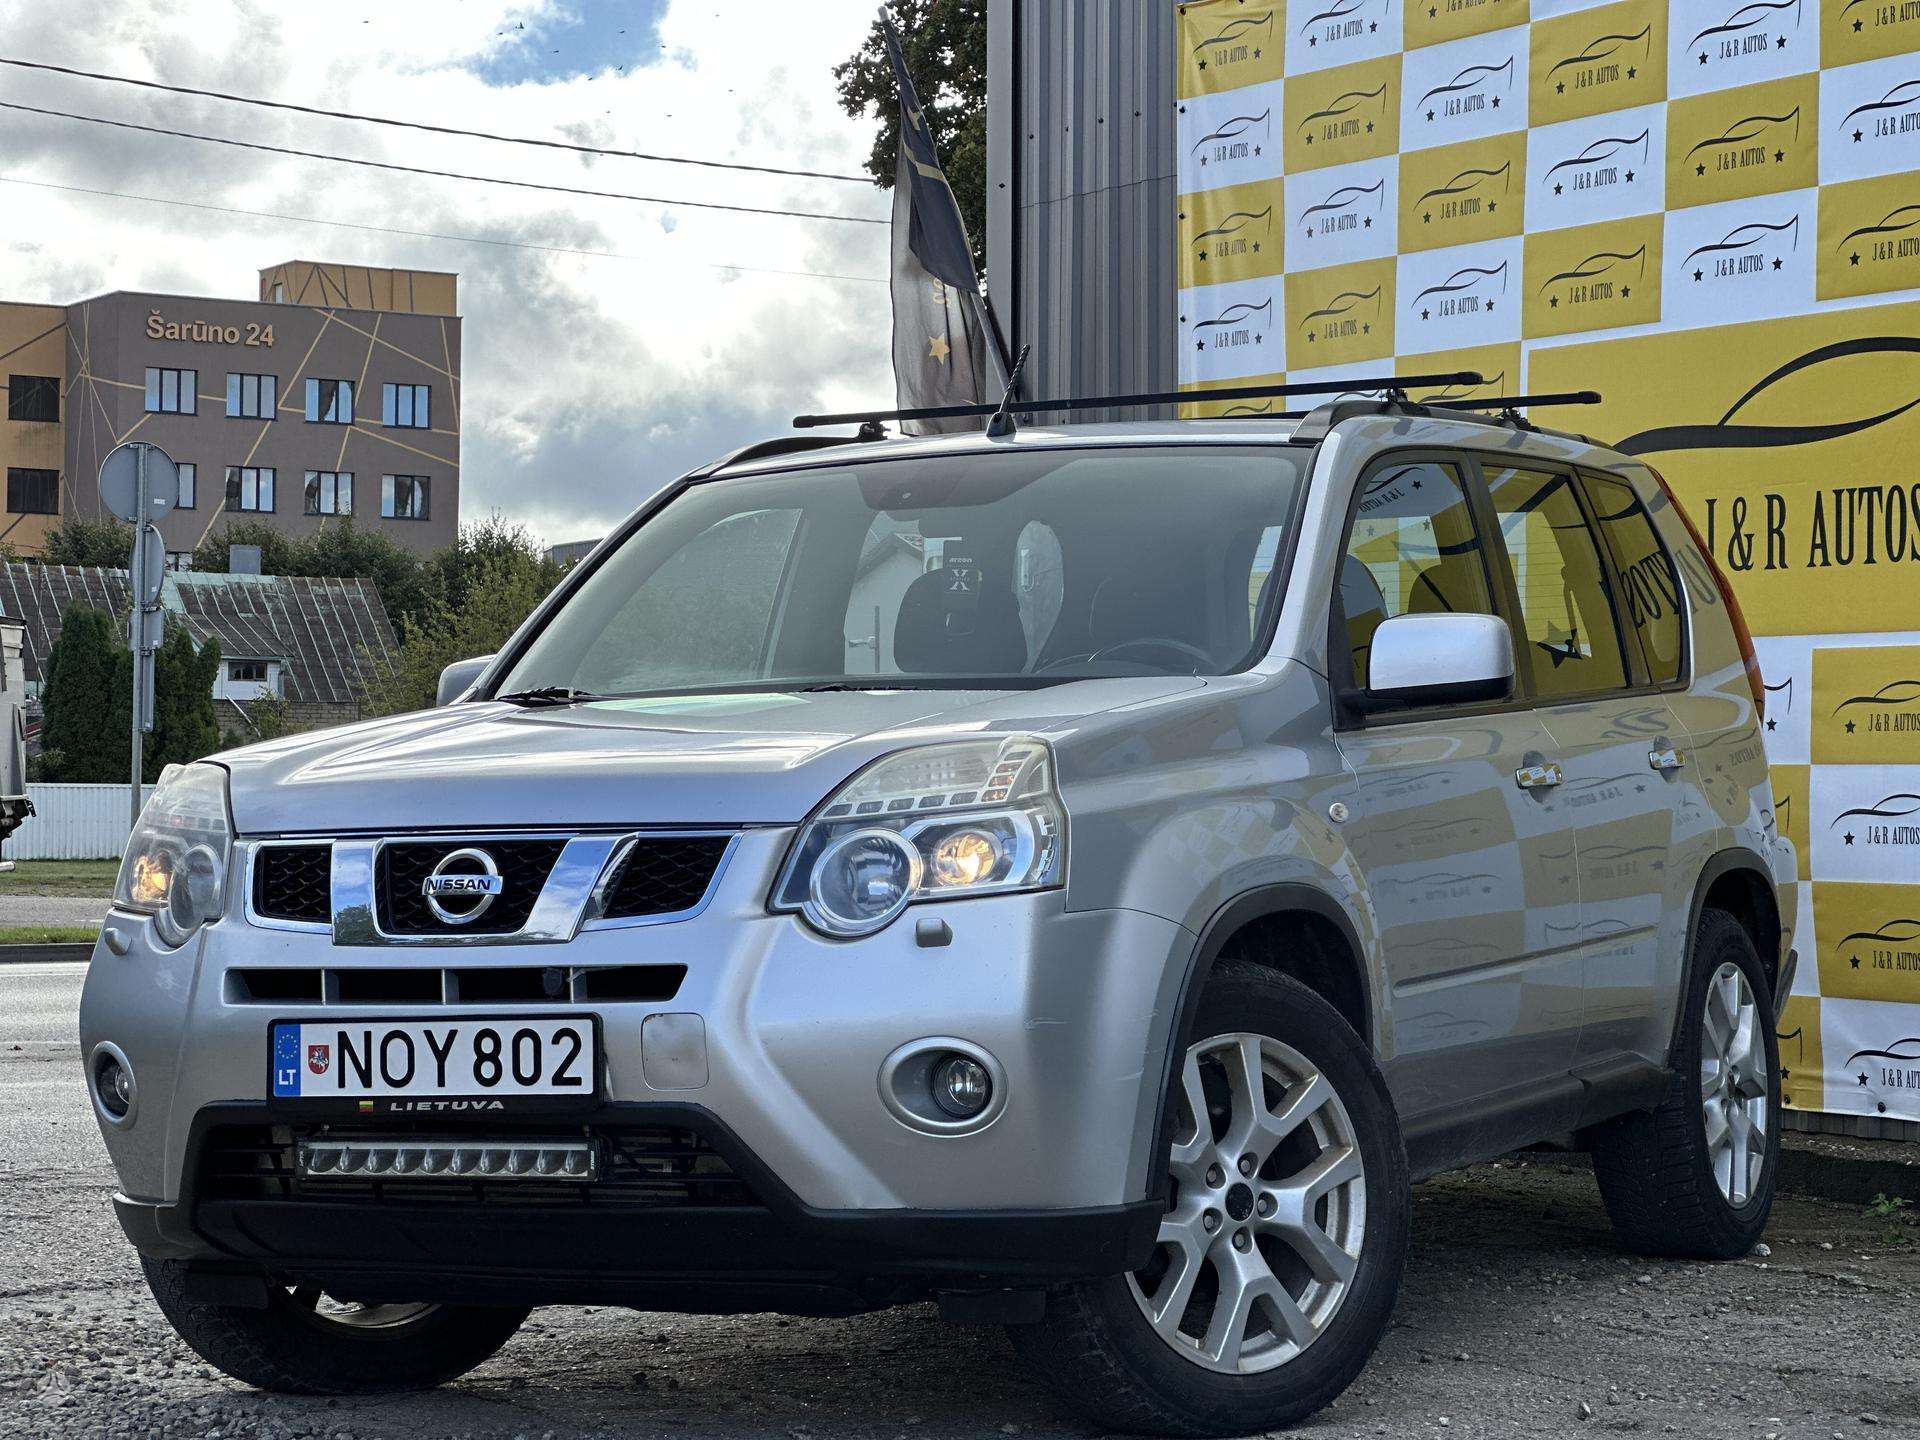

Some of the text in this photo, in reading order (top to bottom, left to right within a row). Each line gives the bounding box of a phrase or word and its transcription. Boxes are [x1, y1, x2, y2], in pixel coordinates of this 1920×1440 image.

[1343, 19, 1363, 38] AUTOS
[1741, 33, 1767, 54] AUTOS
[1230, 45, 1248, 63] AUTOS
[1596, 64, 1619, 84] AUTOS
[1463, 94, 1485, 112] AUTOS
[1340, 119, 1359, 137] AUTOS
[1228, 143, 1249, 159] AUTOS
[1740, 147, 1766, 167] AUTOS
[1594, 167, 1617, 186] AUTOS
[1459, 198, 1481, 216] AUTOS
[1337, 214, 1357, 230] AUTOS
[1231, 239, 1247, 255] AUTOS
[1737, 254, 1764, 273] AUTOS
[1589, 282, 1613, 301] AUTOS
[1457, 296, 1479, 314] AUTOS
[146, 309, 275, 347] Šarūno 24
[1340, 320, 1358, 336] AUTOS
[1230, 332, 1250, 346] AUTOS
[1891, 827, 1920, 844] AUTOS
[427, 878, 491, 891] NISSAN
[337, 1028, 583, 1088] NOY 802
[278, 1069, 297, 1085] LT
[390, 1100, 504, 1111] LIETUVA
